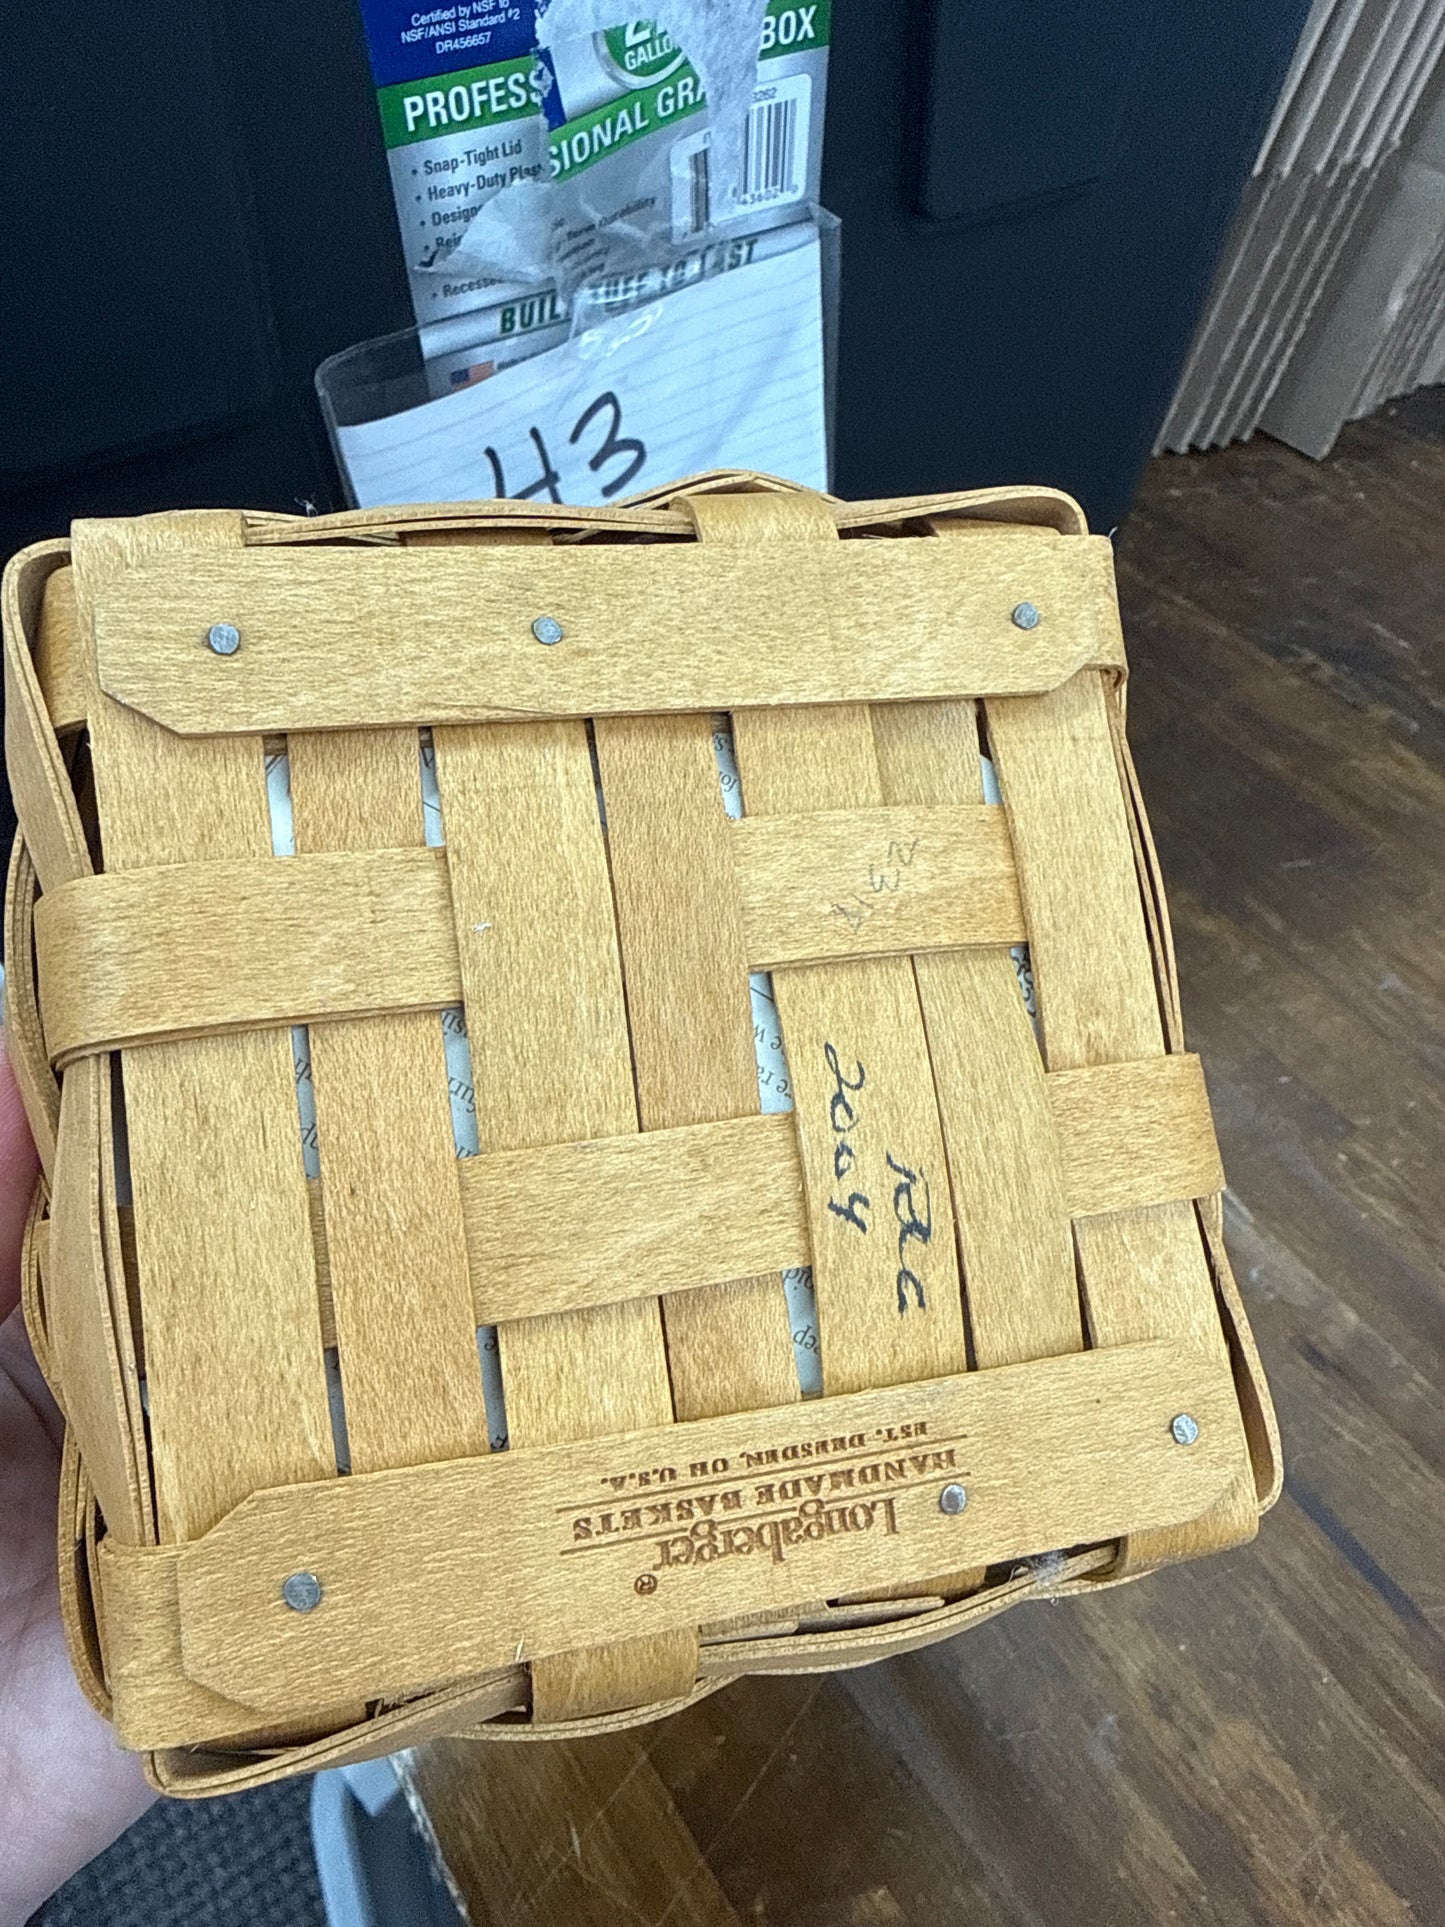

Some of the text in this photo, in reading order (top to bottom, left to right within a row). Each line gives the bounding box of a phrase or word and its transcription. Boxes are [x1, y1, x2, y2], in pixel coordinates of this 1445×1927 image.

[400, 22, 457, 44] NSF/ANSI
[458, 11, 506, 32] Standard
[411, 7, 457, 27] Certified
[458, 5, 471, 19] by
[760, 5, 817, 50] BOX
[423, 139, 523, 176] Snap-Tight Lid
[427, 171, 508, 201] Heavy-Duty
[500, 296, 562, 334] BUIL
[484, 391, 647, 503] 43
[600, 1466, 677, 1491] U.S.A.
[689, 1457, 729, 1478] OH
[572, 1449, 957, 1542] HANDMADE BASKETS
